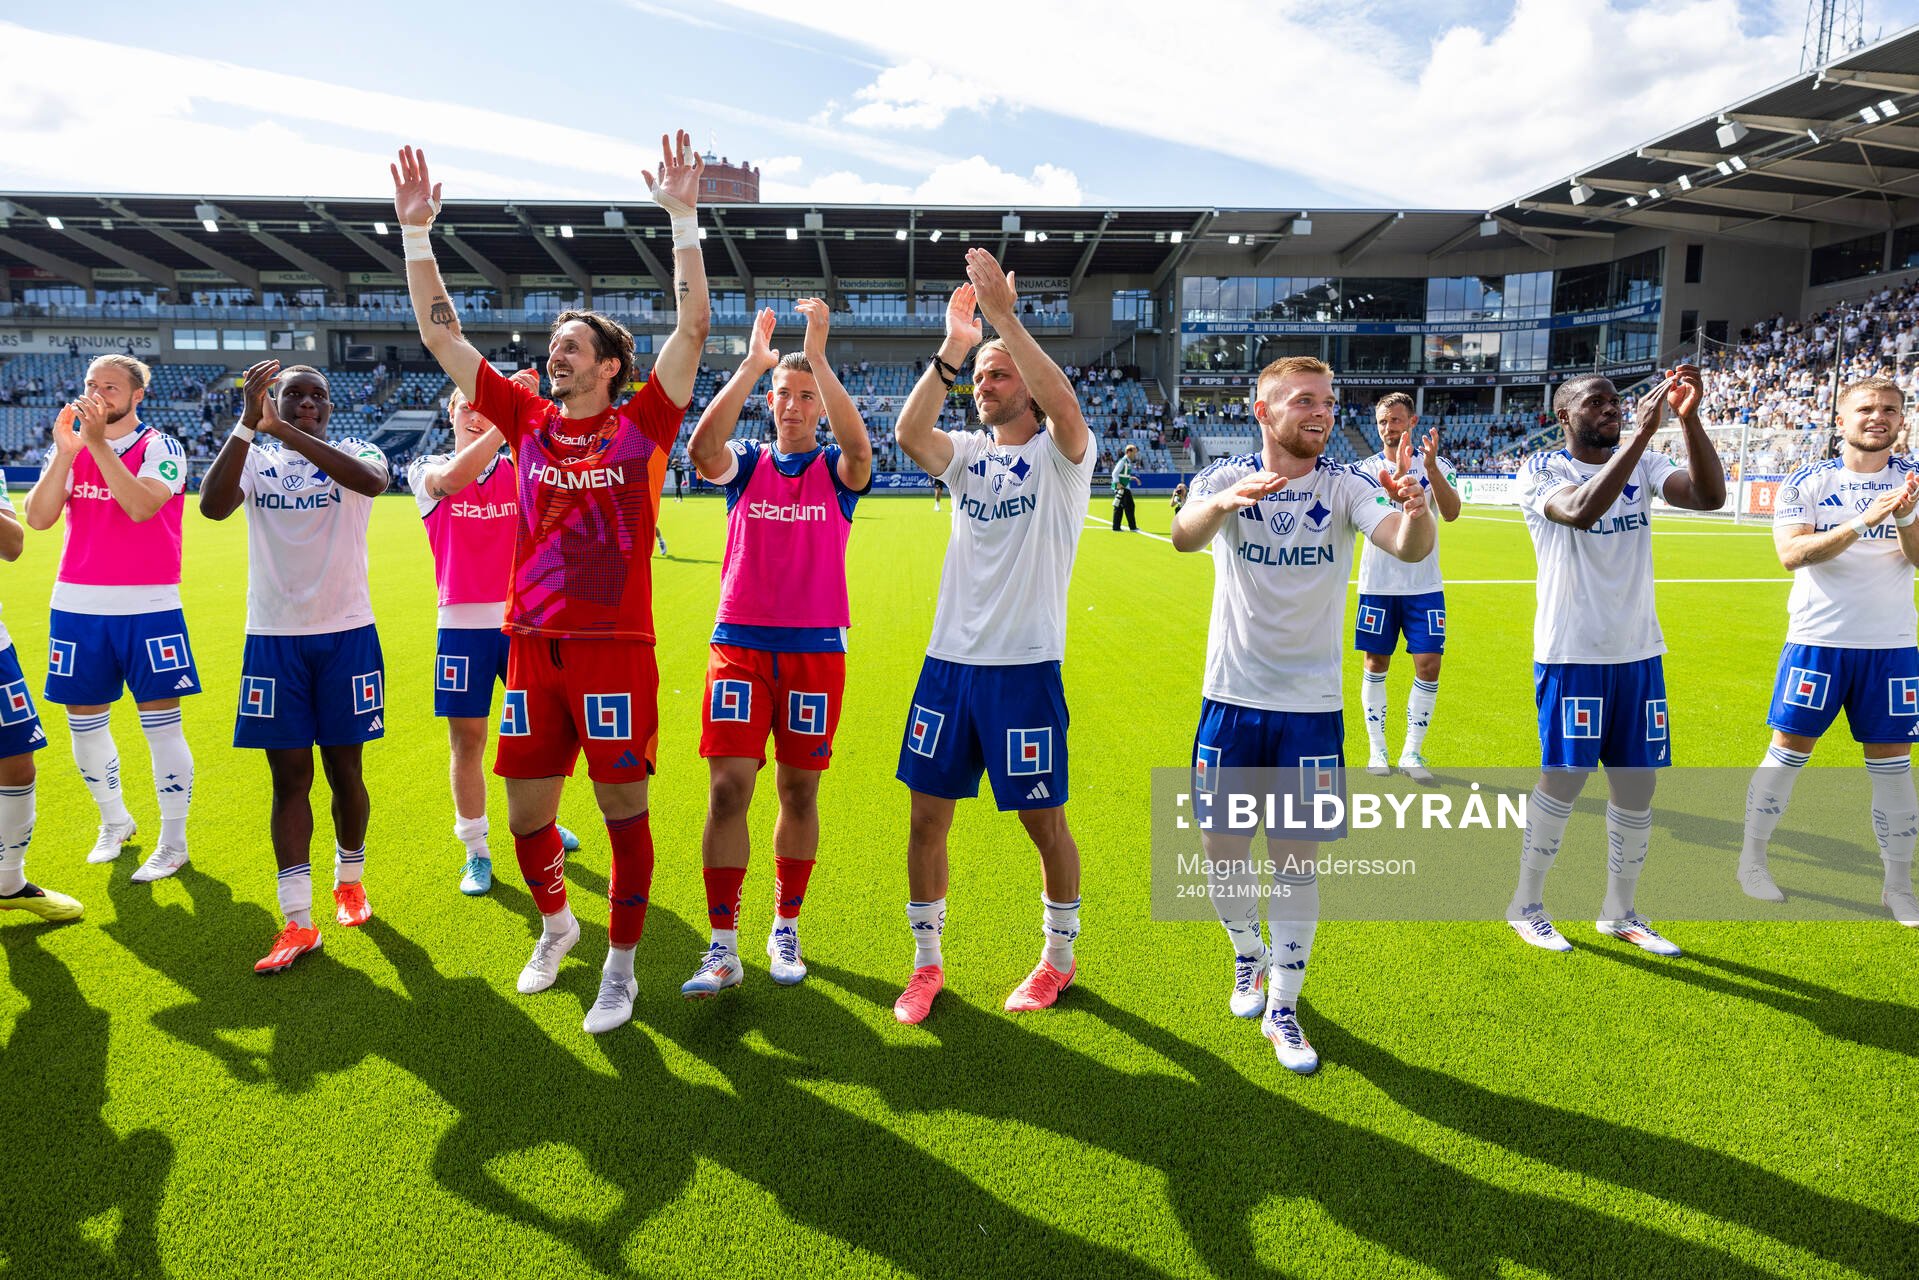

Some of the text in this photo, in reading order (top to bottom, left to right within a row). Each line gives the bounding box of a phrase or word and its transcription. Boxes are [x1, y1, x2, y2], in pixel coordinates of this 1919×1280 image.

[839, 279, 905, 288] Handelsbanken
[1016, 279, 1069, 289] INUMCARS
[48, 335, 152, 349] PLATINUMCARS
[1446, 377, 1475, 385] PEPSI
[1511, 375, 1541, 384] PEPSI
[528, 463, 625, 490] HOLMEN
[1840, 481, 1892, 491] stadium
[73, 481, 113, 501] stad
[255, 488, 342, 510] HOLMEN
[450, 500, 518, 520] stadium
[748, 499, 826, 523] stadium
[959, 492, 1037, 522] HOLMEN
[1575, 511, 1649, 535] OLMEN
[1237, 541, 1335, 566] HOLMEN
